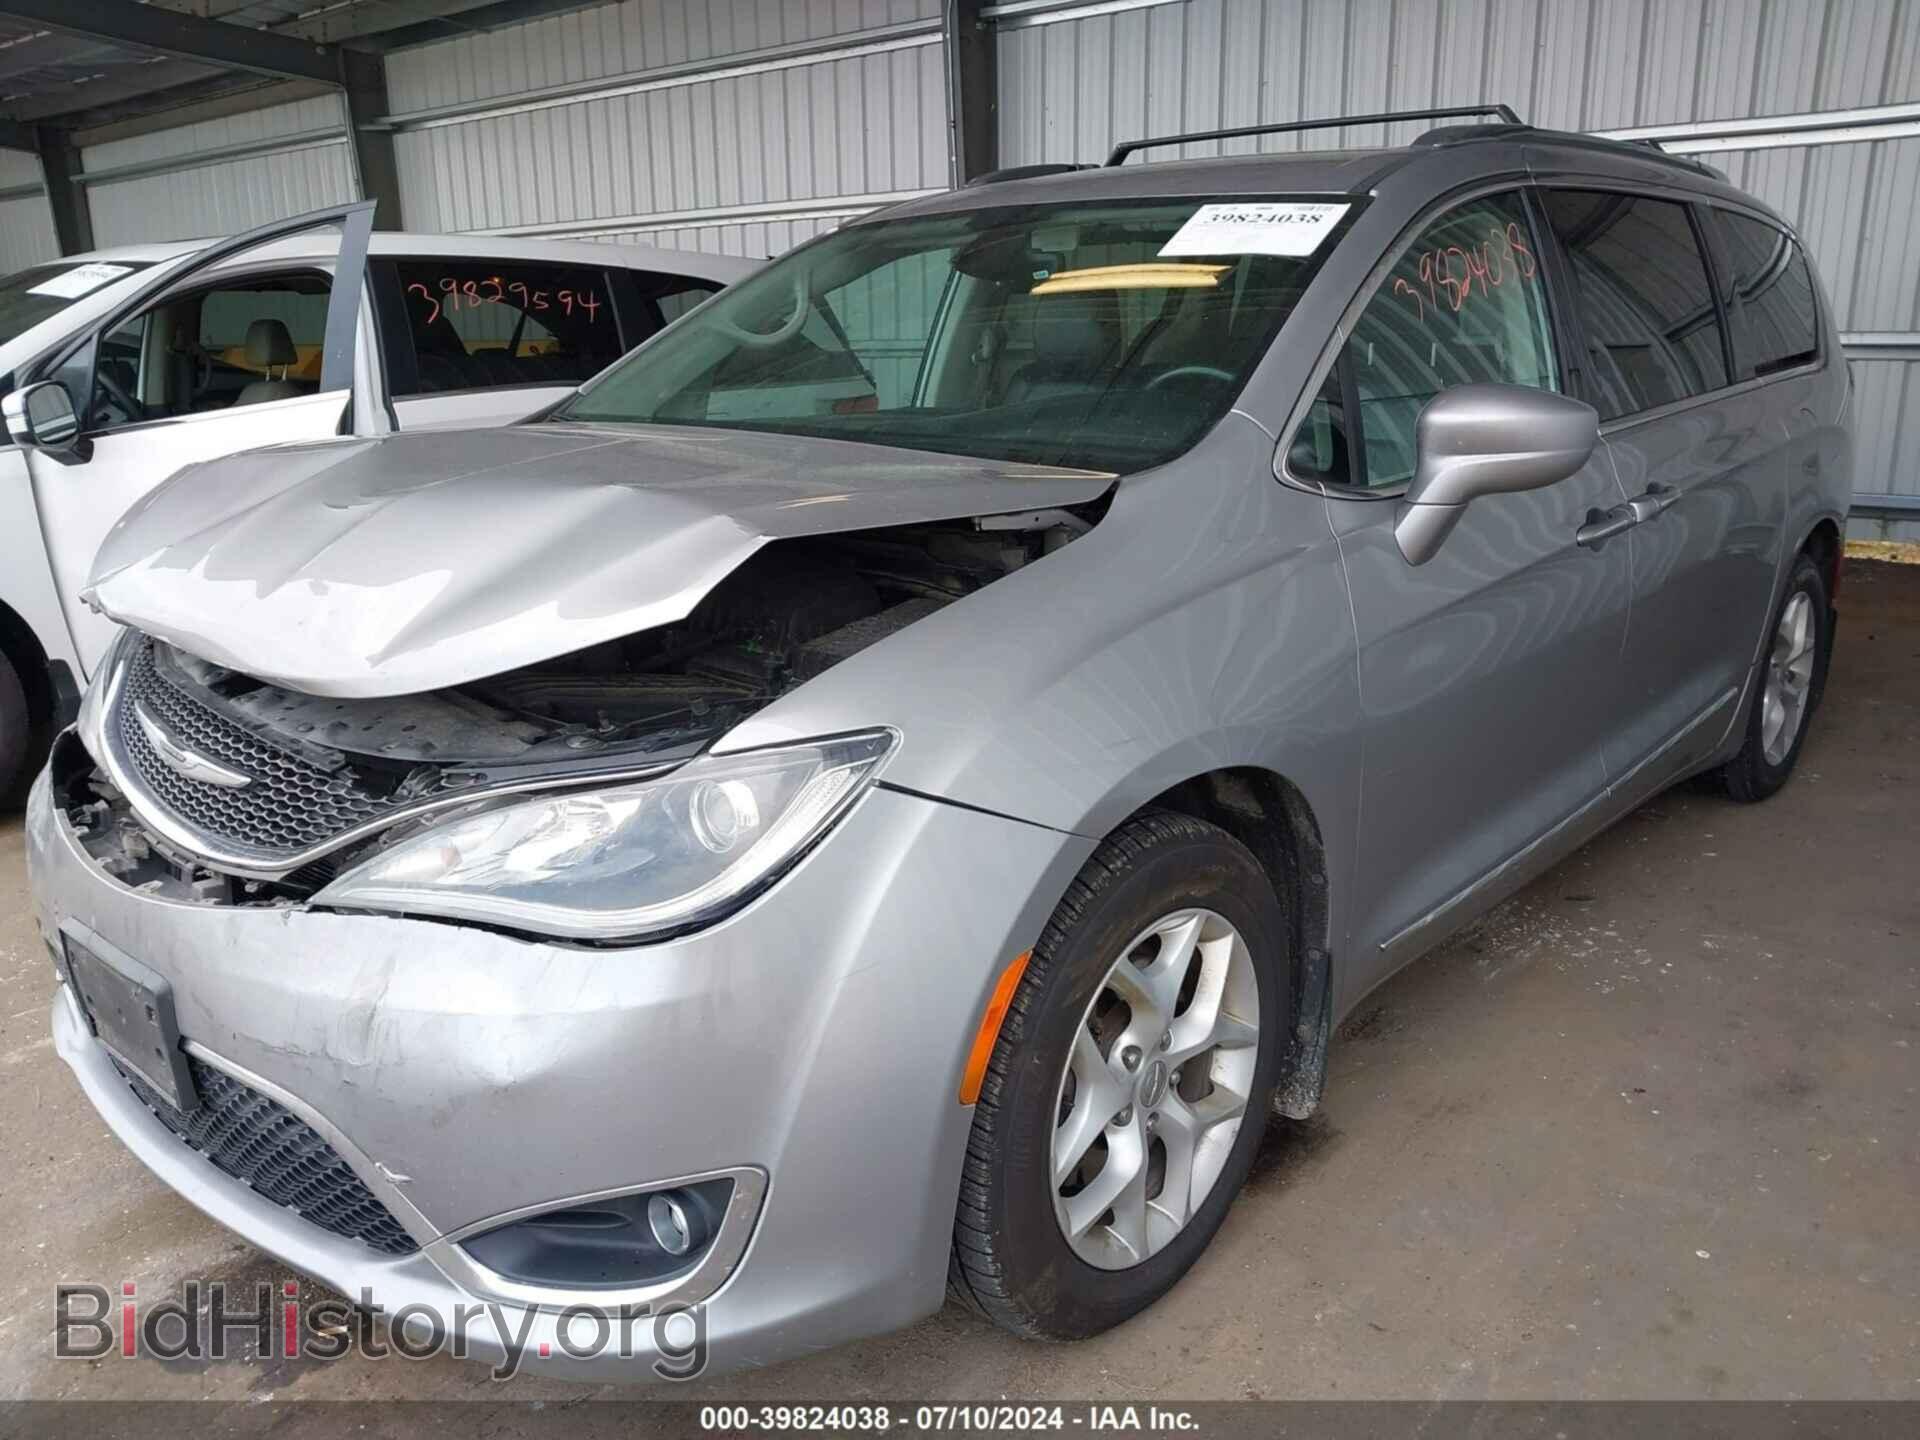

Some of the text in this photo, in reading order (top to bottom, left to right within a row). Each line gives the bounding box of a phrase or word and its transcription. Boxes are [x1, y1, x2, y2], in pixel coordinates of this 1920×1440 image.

[1204, 212, 1325, 225] 39824038
[1395, 222, 1536, 322] 39824038
[407, 278, 601, 324] 39829594
